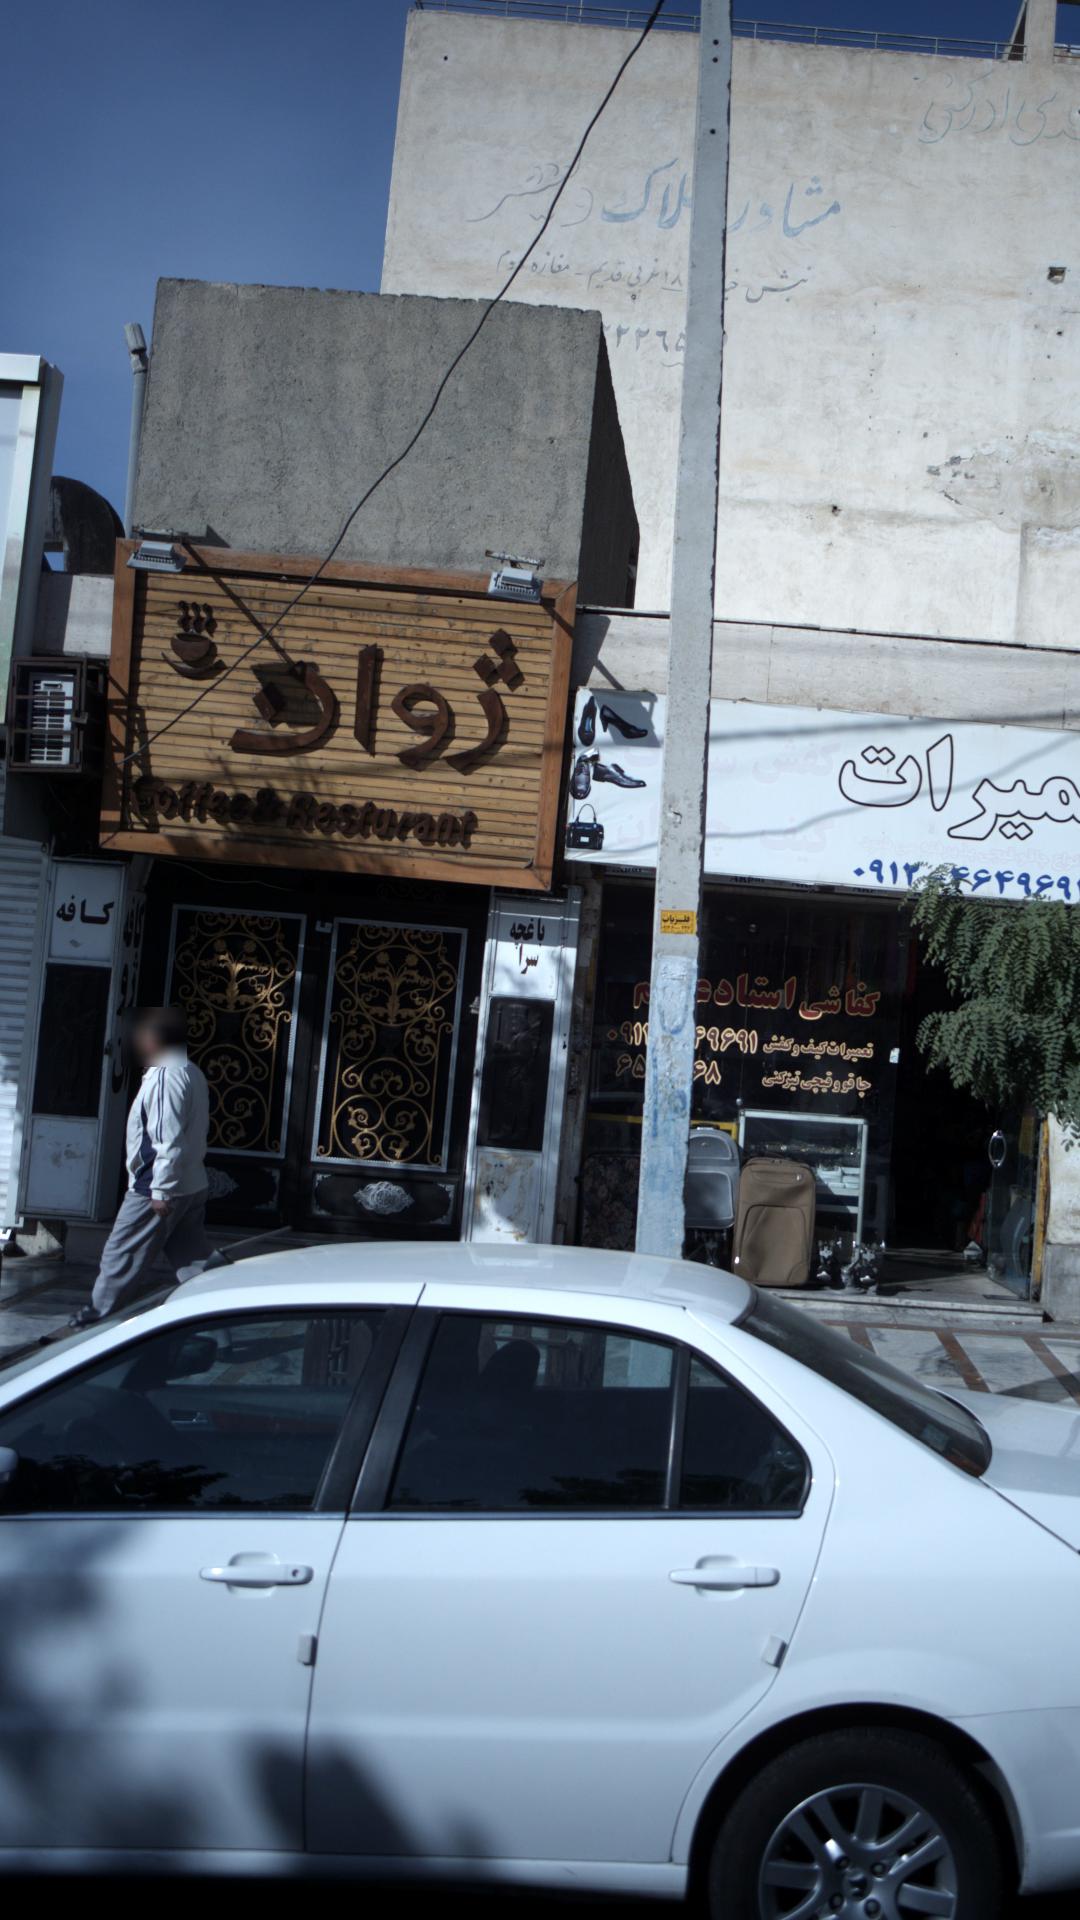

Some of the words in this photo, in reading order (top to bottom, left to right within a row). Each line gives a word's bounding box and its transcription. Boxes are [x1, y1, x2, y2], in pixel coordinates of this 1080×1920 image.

[838, 733, 1080, 841] میرات
[56, 894, 115, 925] کافه
[762, 1034, 795, 1054] کفش
[800, 1038, 829, 1060] کیف
